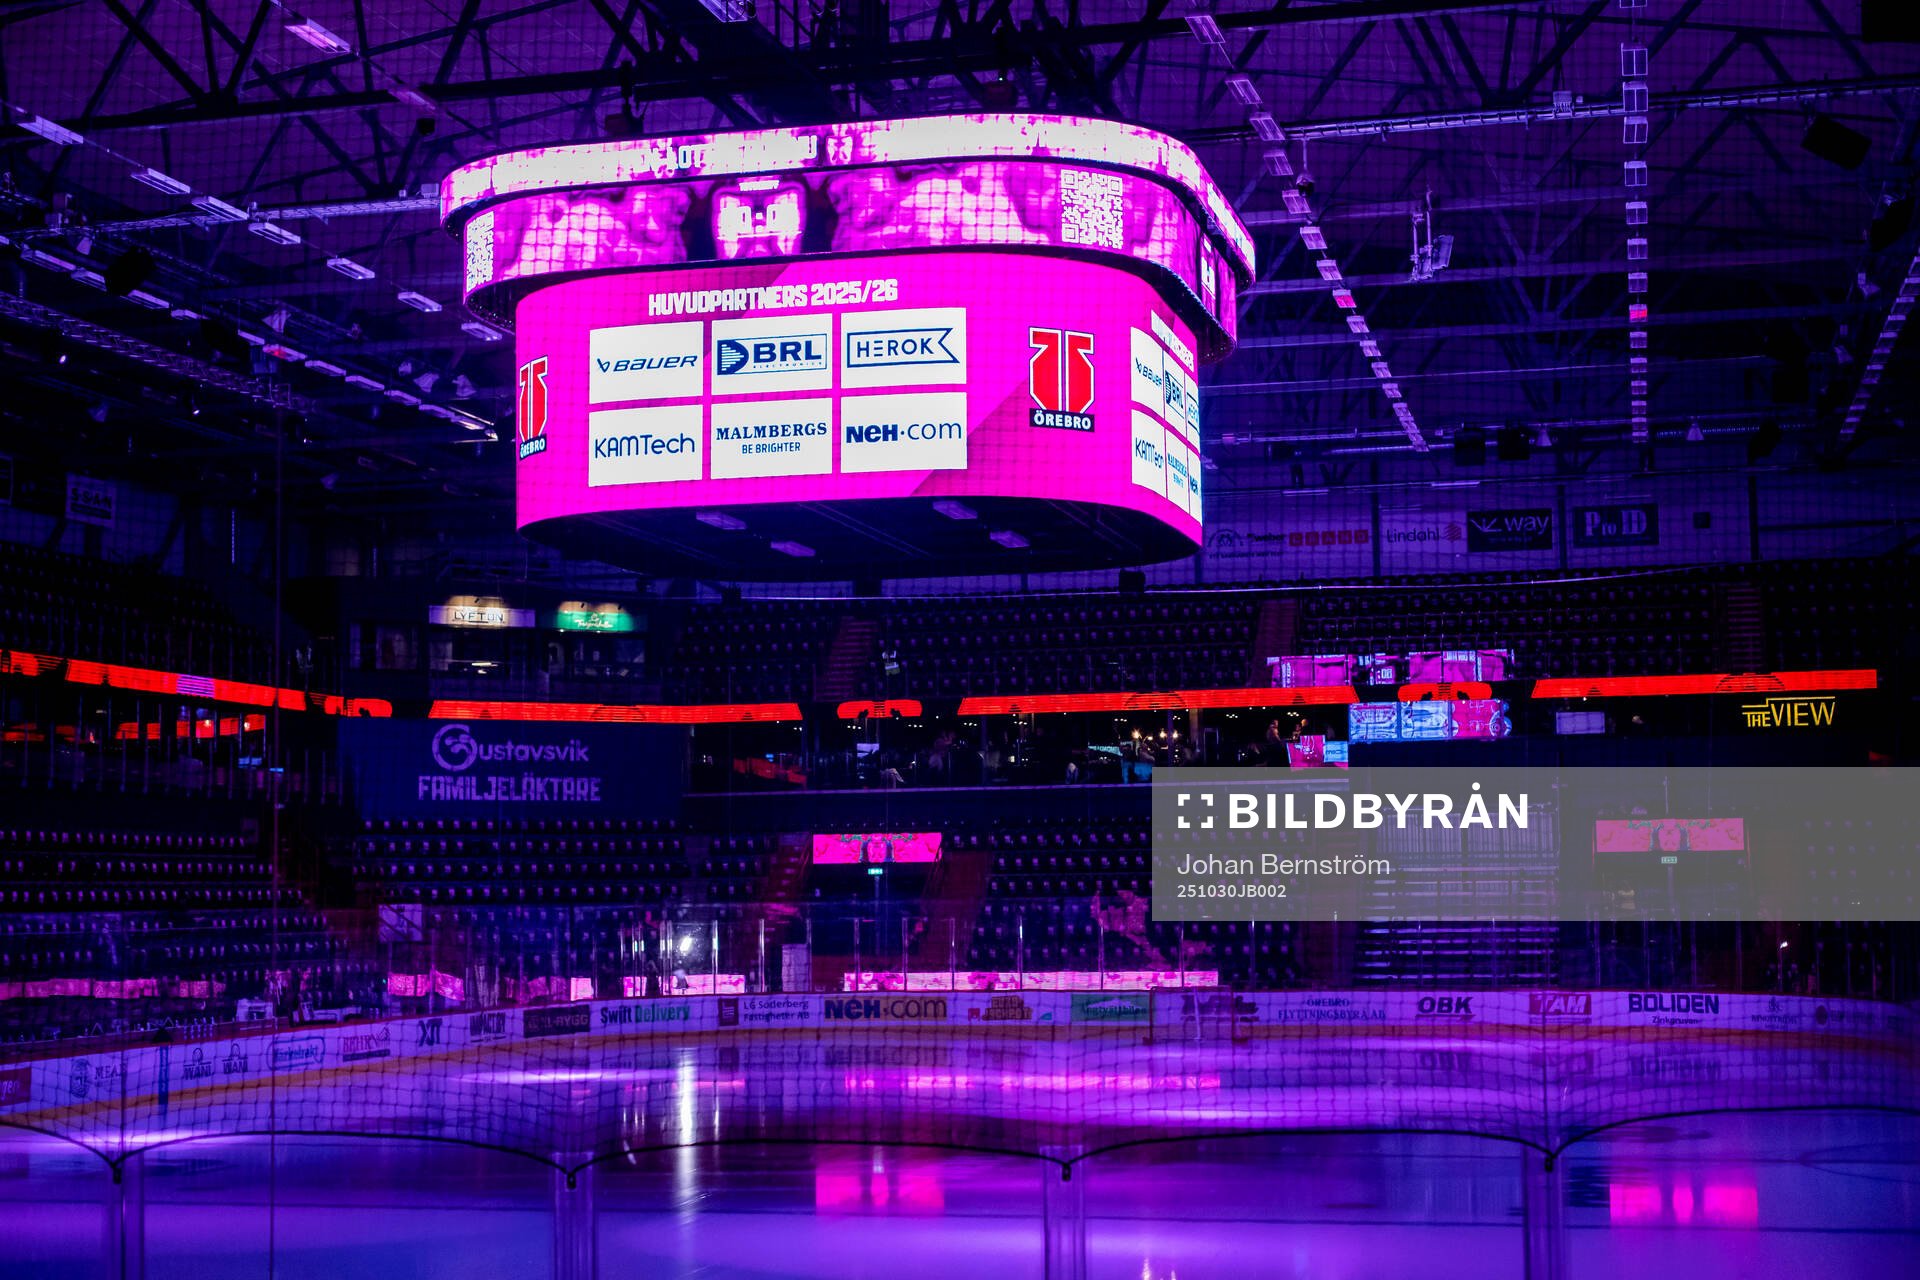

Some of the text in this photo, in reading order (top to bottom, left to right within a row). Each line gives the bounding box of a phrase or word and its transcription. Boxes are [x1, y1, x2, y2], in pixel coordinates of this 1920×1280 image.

[648, 278, 898, 316] HUVUDPARTNERS 2025/26
[753, 340, 822, 364] BRL
[857, 337, 935, 358] HEROK
[1033, 409, 1092, 430] ÖREBRO
[716, 422, 828, 441] MALMBERGS
[594, 432, 695, 459] KAMTech
[741, 442, 801, 455] BE BRIGHTER
[1387, 528, 1440, 543] Lindahl
[1742, 702, 1836, 727] THE VIEW
[418, 771, 601, 801] FAMILJELÄKTARE
[600, 1003, 690, 1025] Swift Delivery
[1417, 996, 1474, 1014] OBK
[1628, 993, 1720, 1014] BOLIDEN
